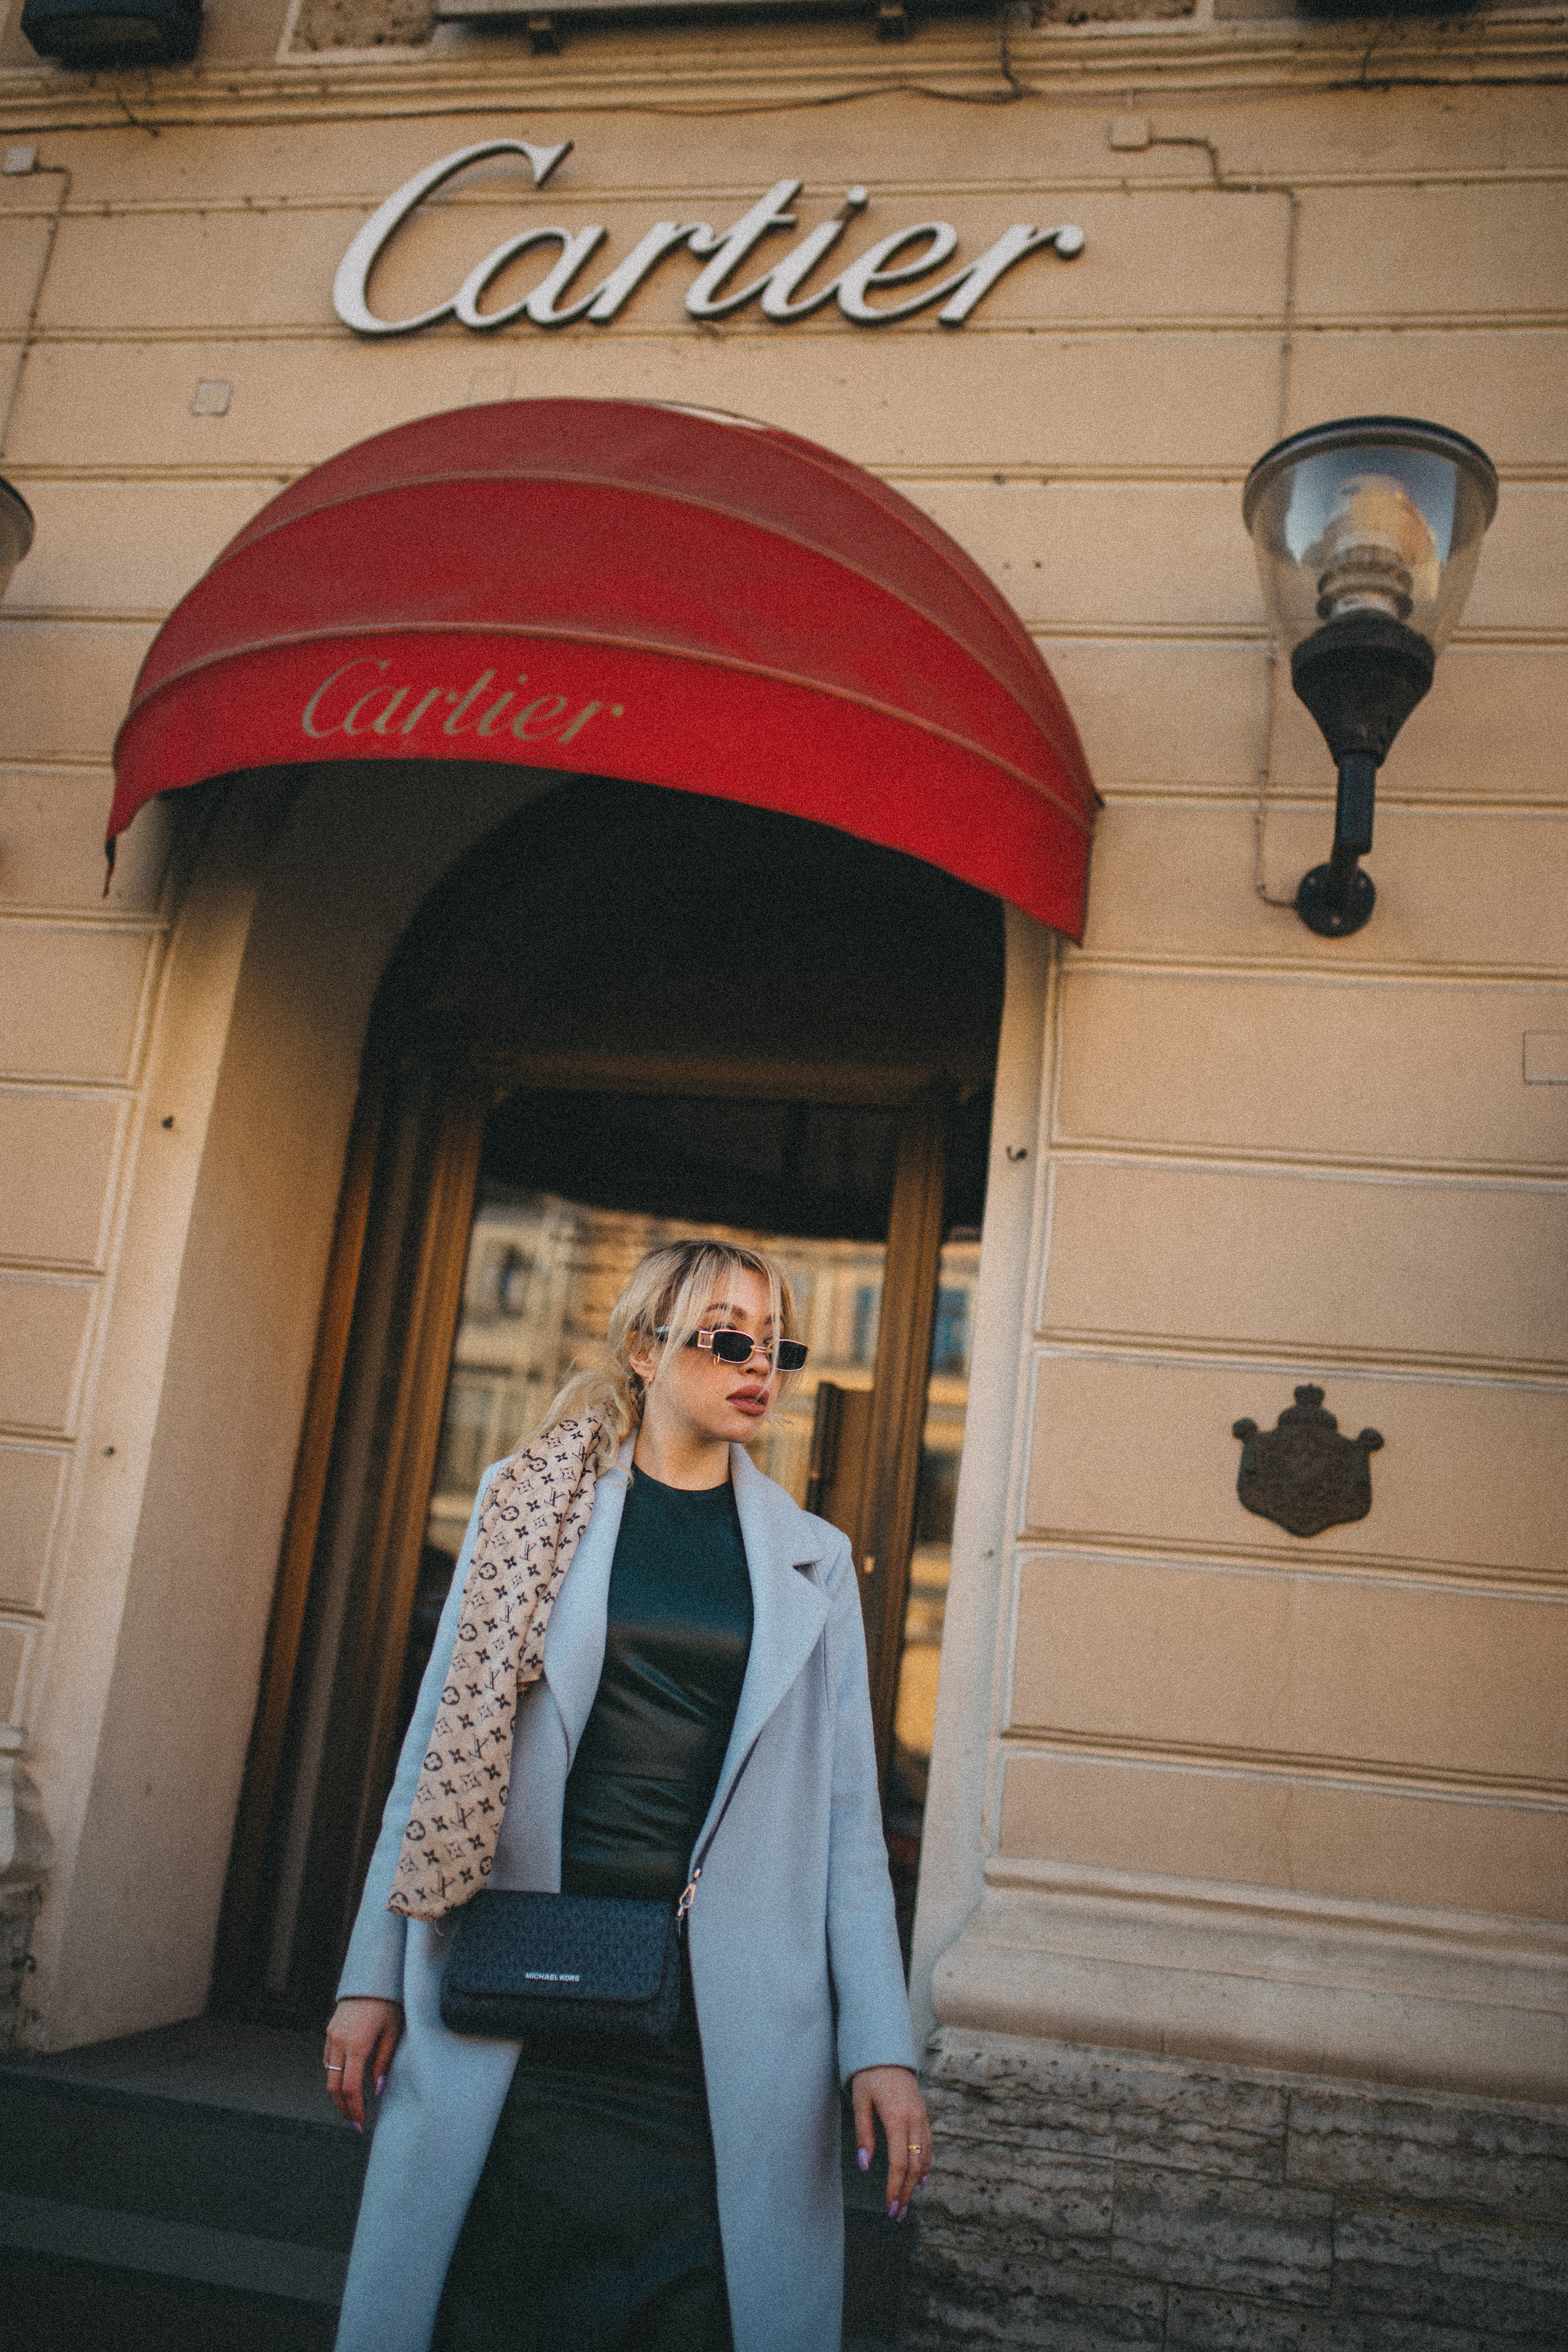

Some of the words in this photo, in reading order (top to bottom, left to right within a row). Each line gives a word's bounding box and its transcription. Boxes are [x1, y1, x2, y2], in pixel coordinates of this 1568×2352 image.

[333, 138, 1085, 333] Cartier
[301, 657, 624, 744] Cartier
[526, 1972, 558, 1981] MICHAEL
